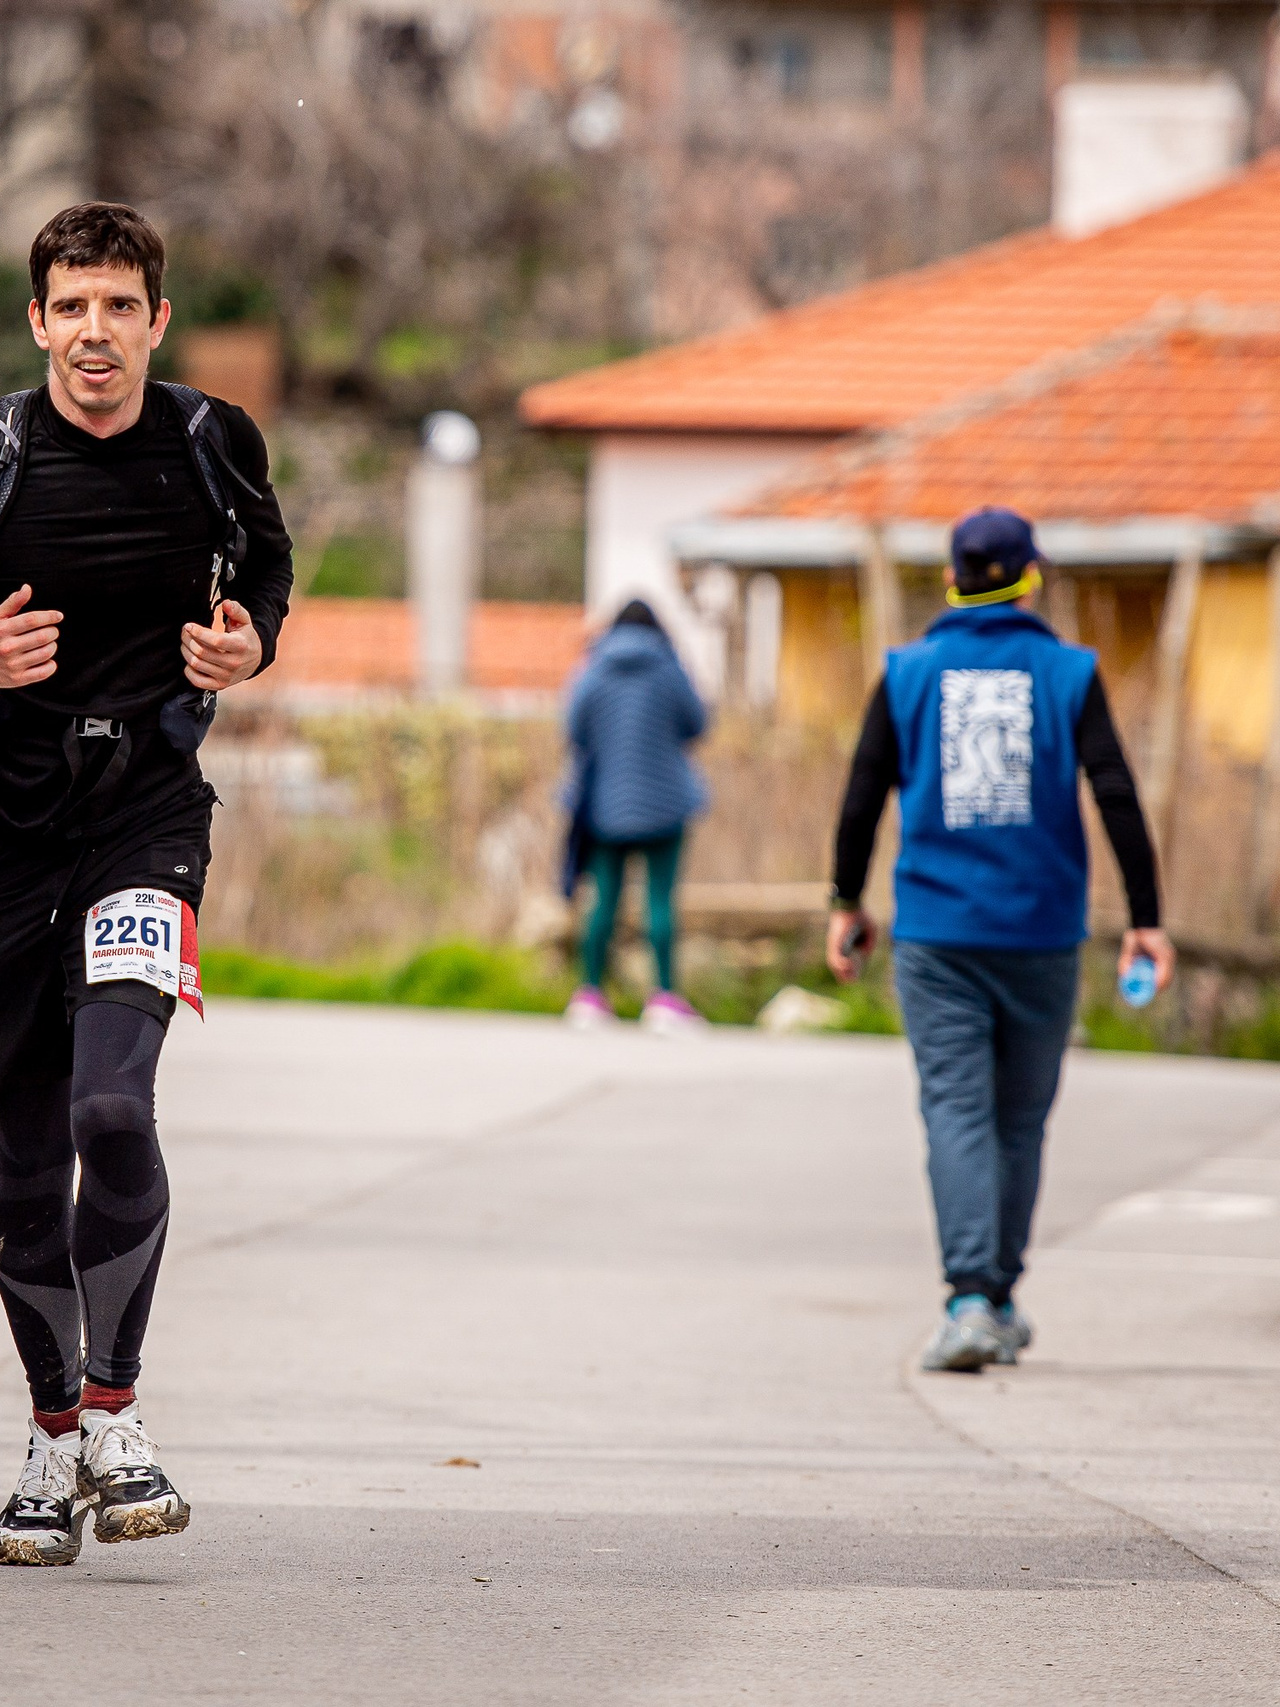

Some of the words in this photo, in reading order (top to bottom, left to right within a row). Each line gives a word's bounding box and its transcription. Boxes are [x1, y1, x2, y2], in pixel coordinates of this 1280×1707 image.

[135, 893, 155, 904] 22K
[95, 915, 171, 953] 2261
[92, 946, 134, 959] MARKOVO
[135, 947, 156, 960] TRAIL
